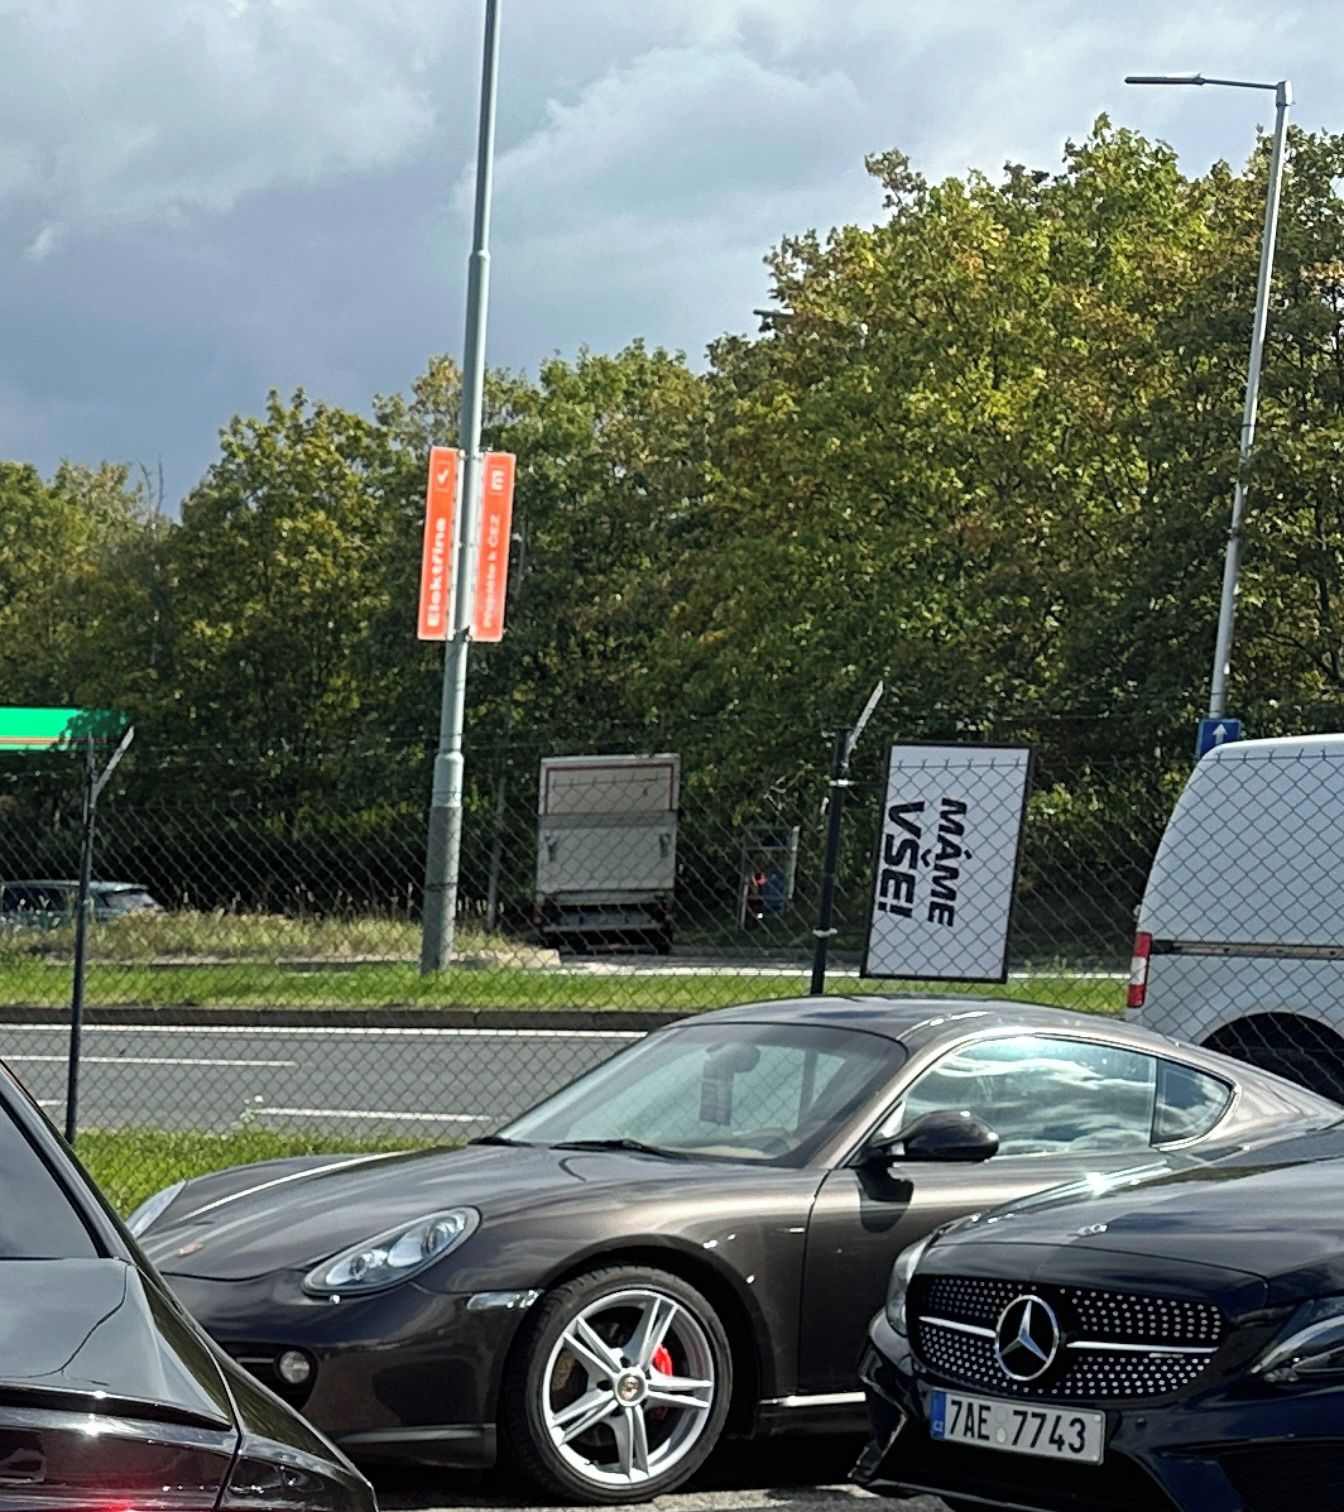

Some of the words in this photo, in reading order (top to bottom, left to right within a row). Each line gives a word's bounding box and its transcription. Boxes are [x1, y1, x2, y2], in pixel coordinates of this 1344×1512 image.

[878, 801, 932, 918] VŠE!
[928, 797, 972, 927] MÁME
[950, 1399, 991, 1441] 7AE
[1012, 1409, 1087, 1454] 7743
